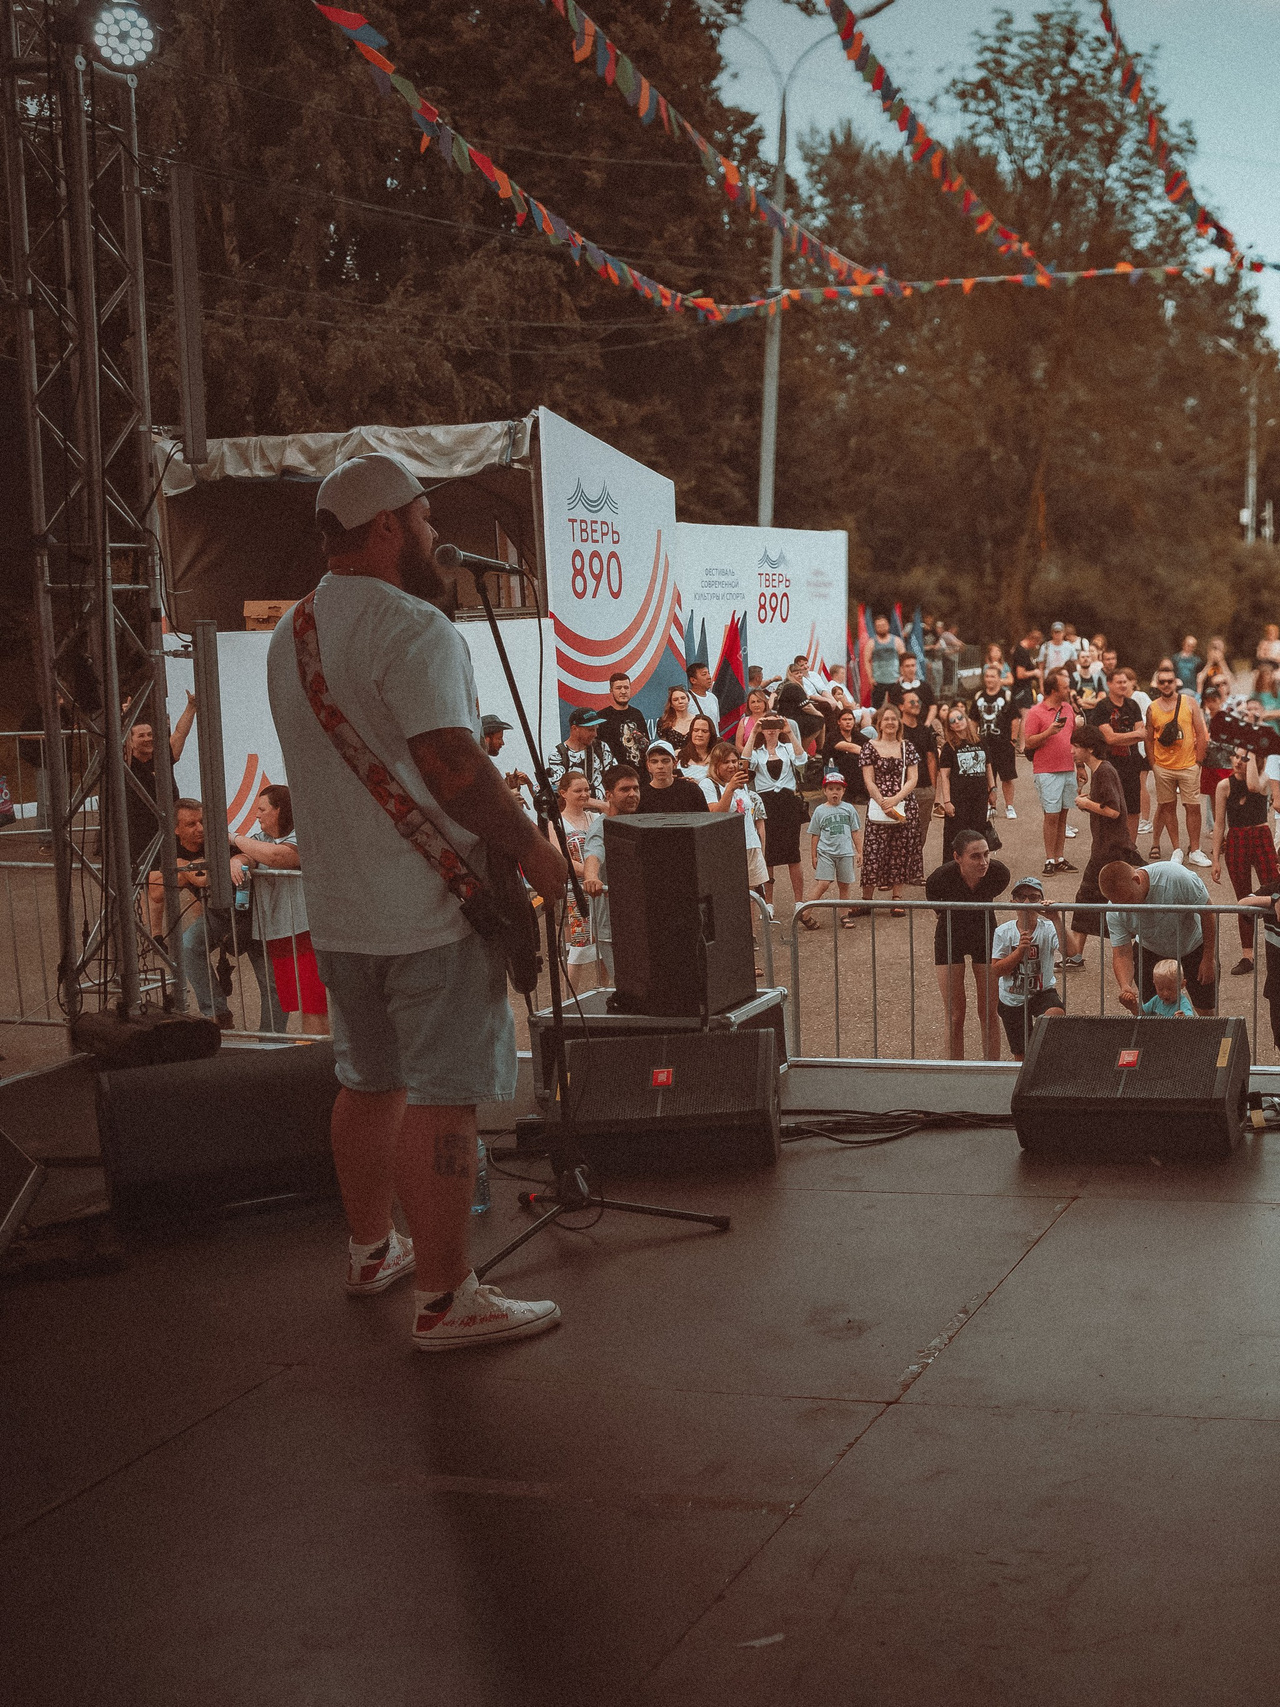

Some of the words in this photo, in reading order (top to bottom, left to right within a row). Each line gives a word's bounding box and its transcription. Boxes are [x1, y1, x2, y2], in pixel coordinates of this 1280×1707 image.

[567, 518, 620, 545] ТВЕРЬ
[571, 548, 623, 600] 890
[704, 568, 735, 577] ФЕСТИВАЛЬ
[757, 572, 791, 588] ТВЕРЬ
[700, 579, 739, 588] СОВРЕМЕННОЙ
[694, 592, 720, 601] КУЛЬТУРЫ
[726, 592, 746, 601] СПОРТА
[757, 591, 790, 624] 890
